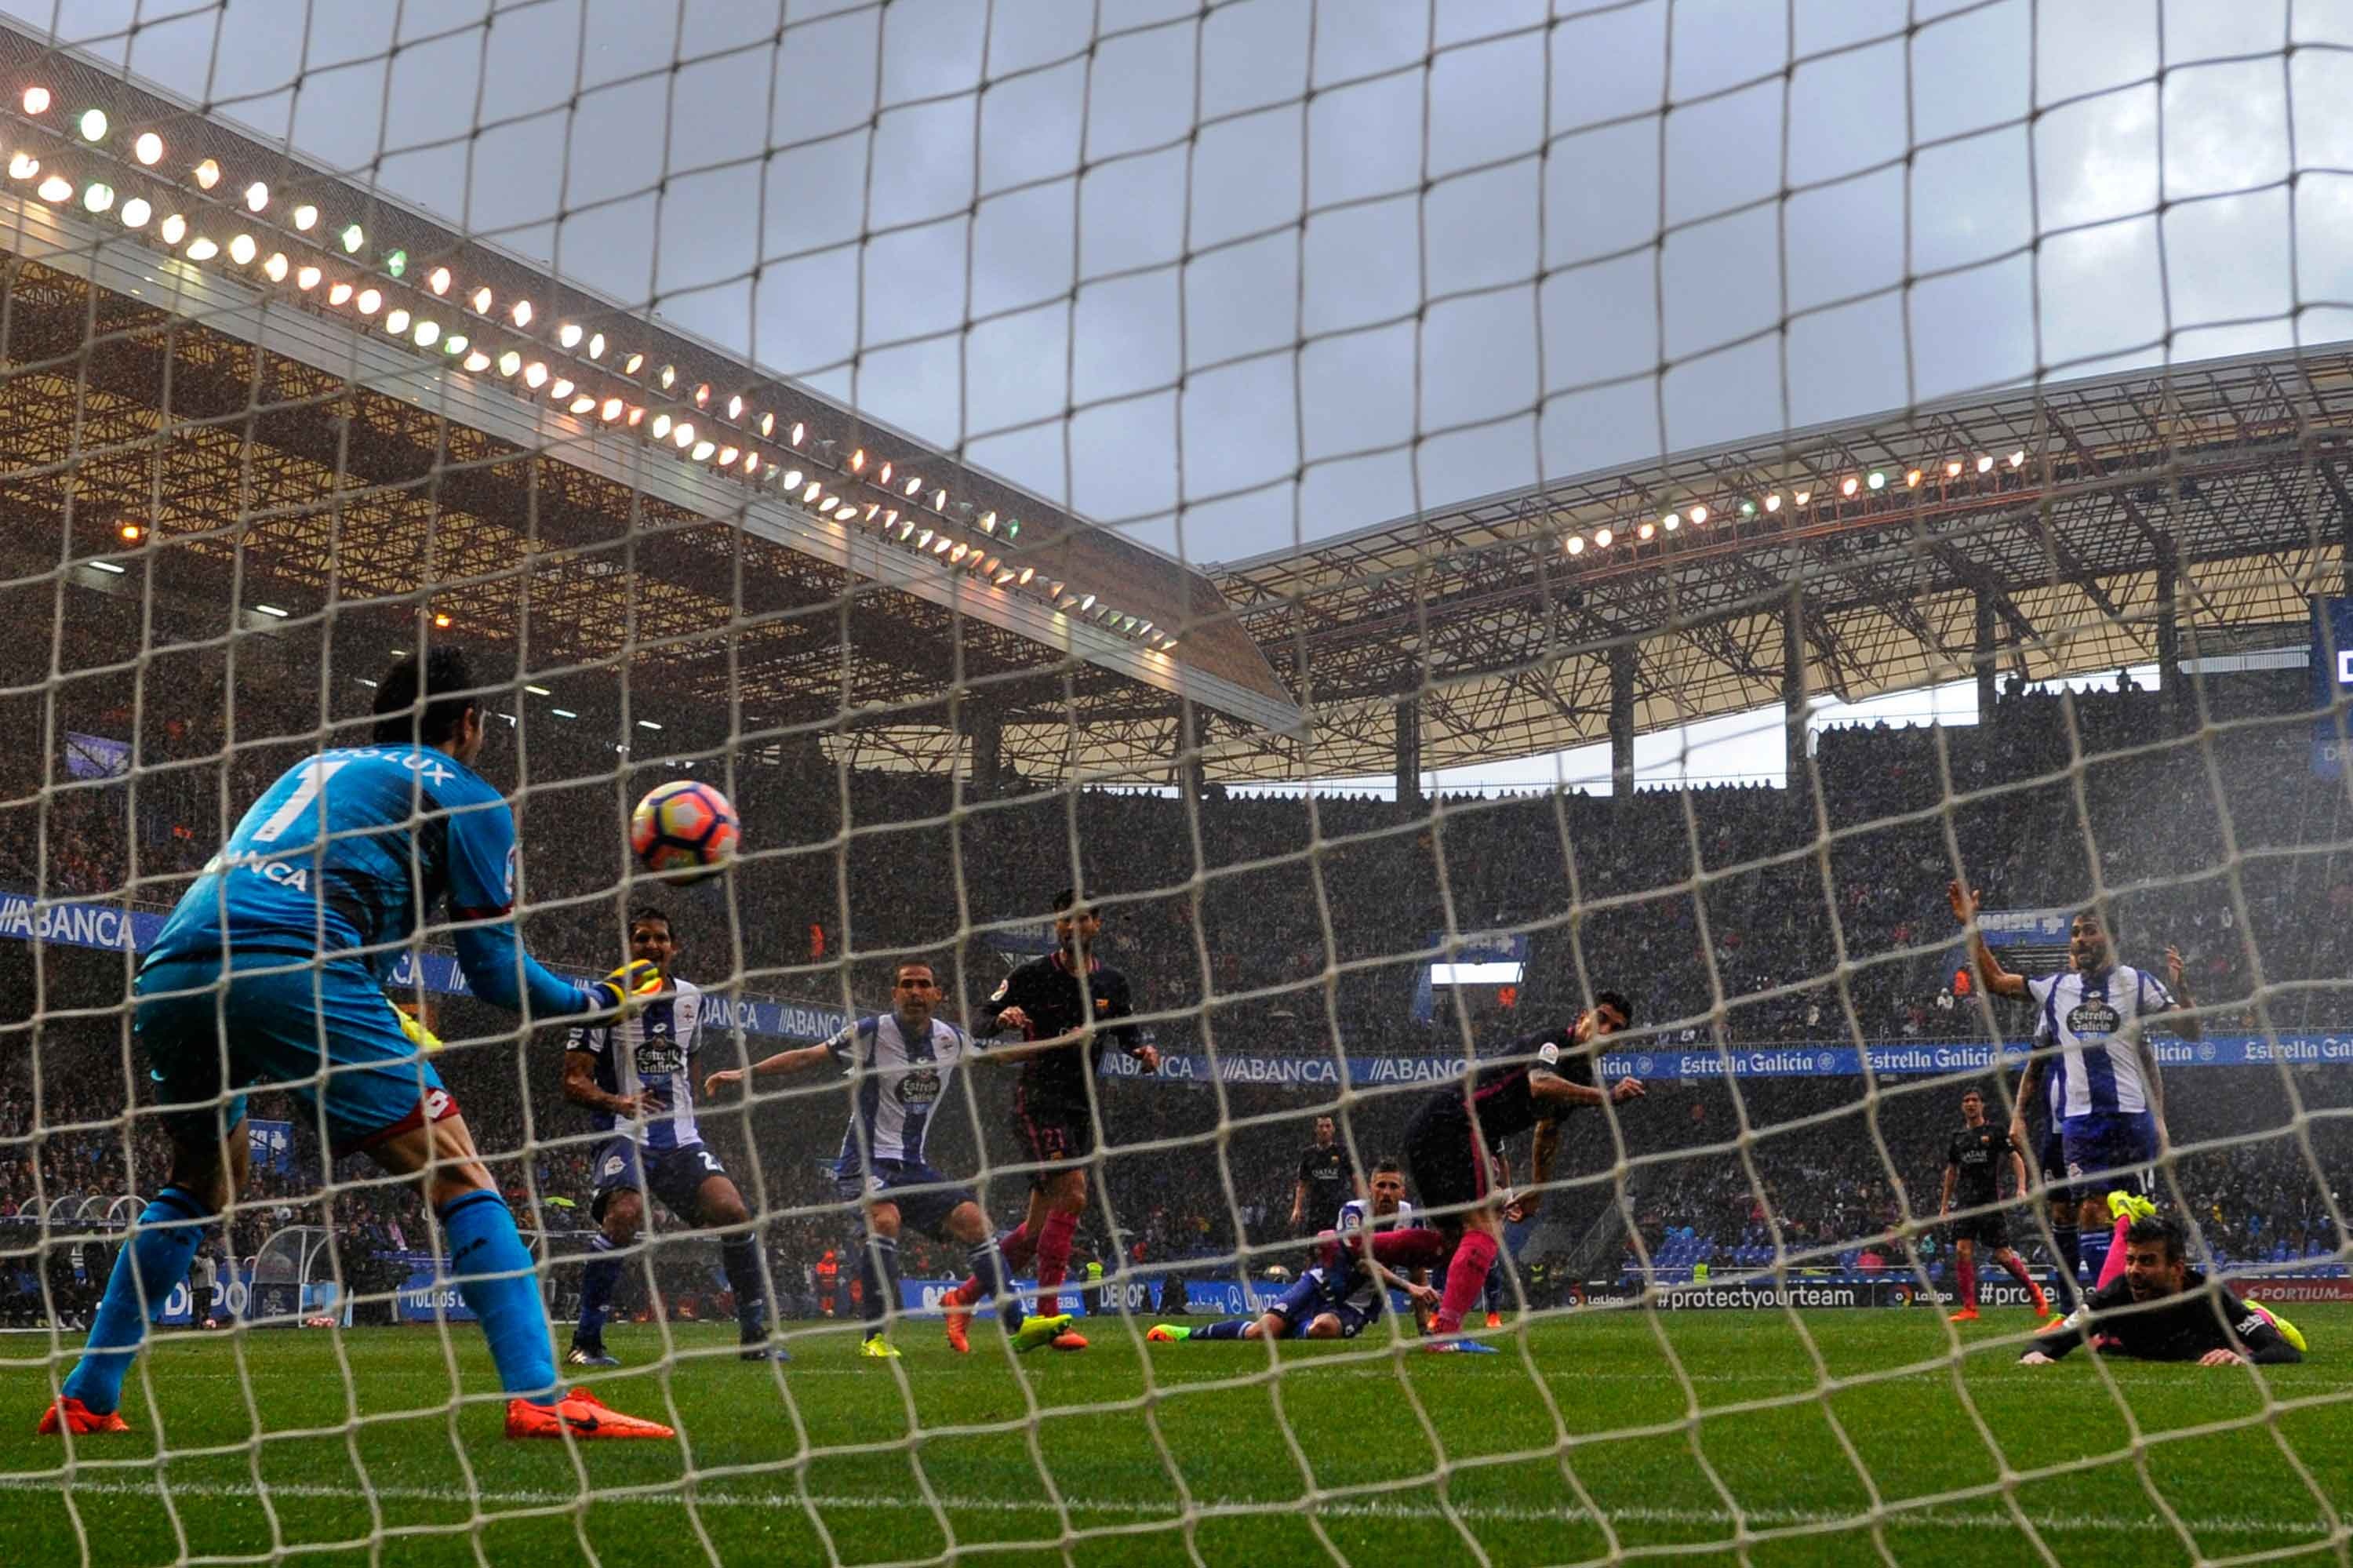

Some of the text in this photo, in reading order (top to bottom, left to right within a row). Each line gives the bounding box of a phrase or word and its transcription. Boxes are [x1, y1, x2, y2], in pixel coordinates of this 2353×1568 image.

[251, 760, 351, 842] 1
[1679, 1055, 1747, 1075] Estrella
[1750, 1052, 1813, 1072] Galicia
